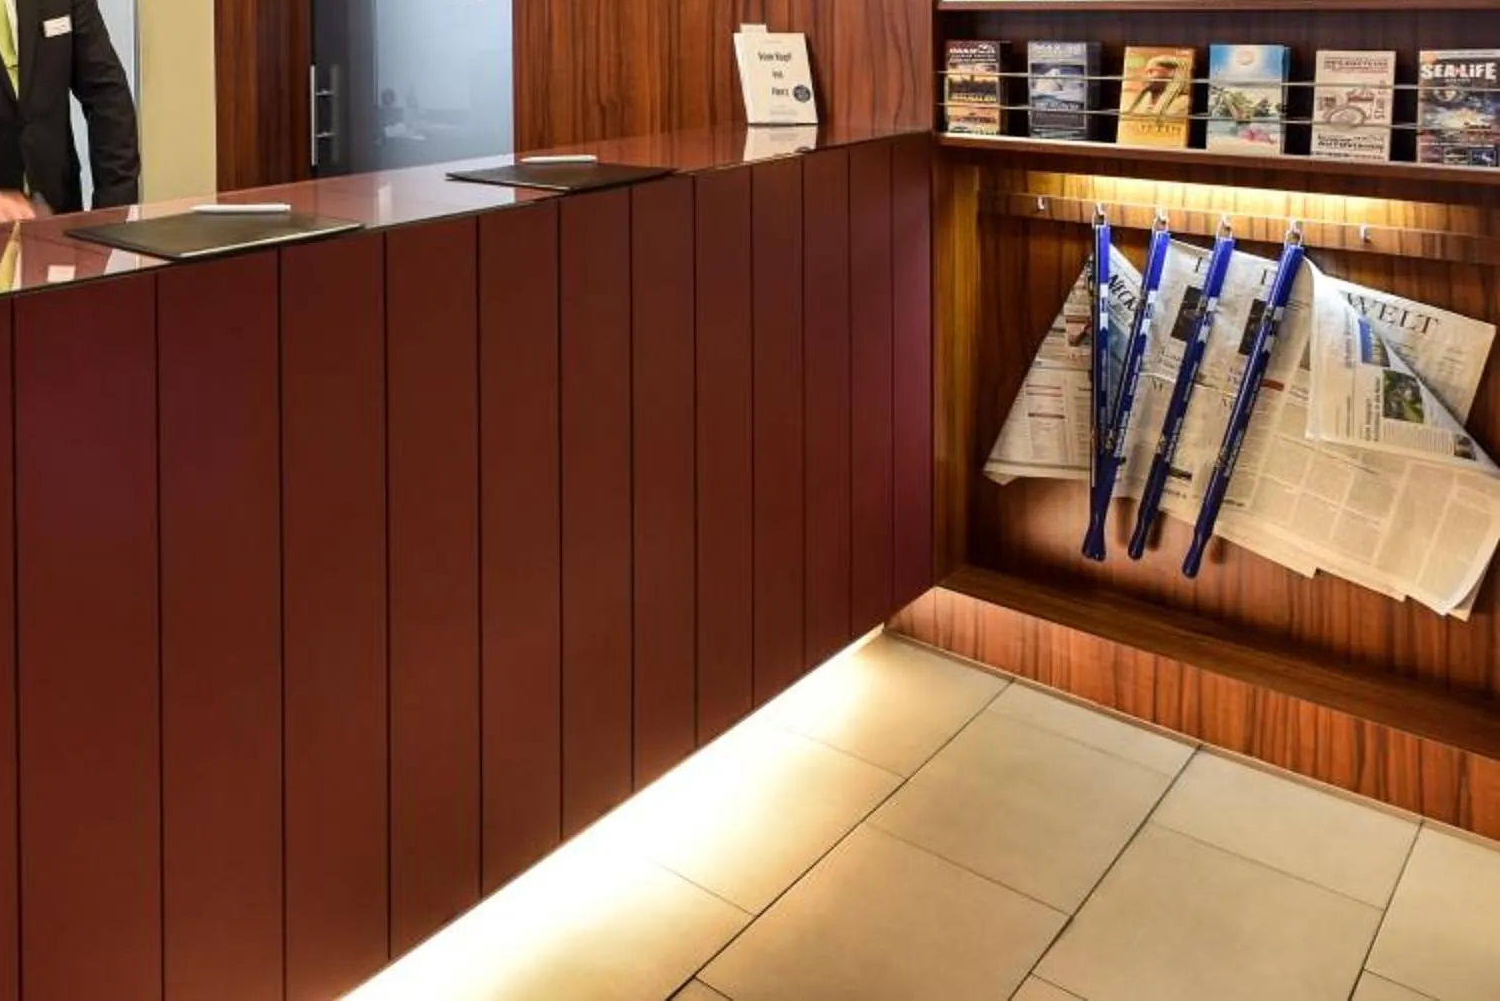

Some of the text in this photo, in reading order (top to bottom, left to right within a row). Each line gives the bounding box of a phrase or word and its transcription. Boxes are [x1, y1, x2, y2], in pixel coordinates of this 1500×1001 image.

[1420, 63, 1456, 80] SEA
[1107, 274, 1137, 311] NECK
[1339, 290, 1439, 334] WELT
